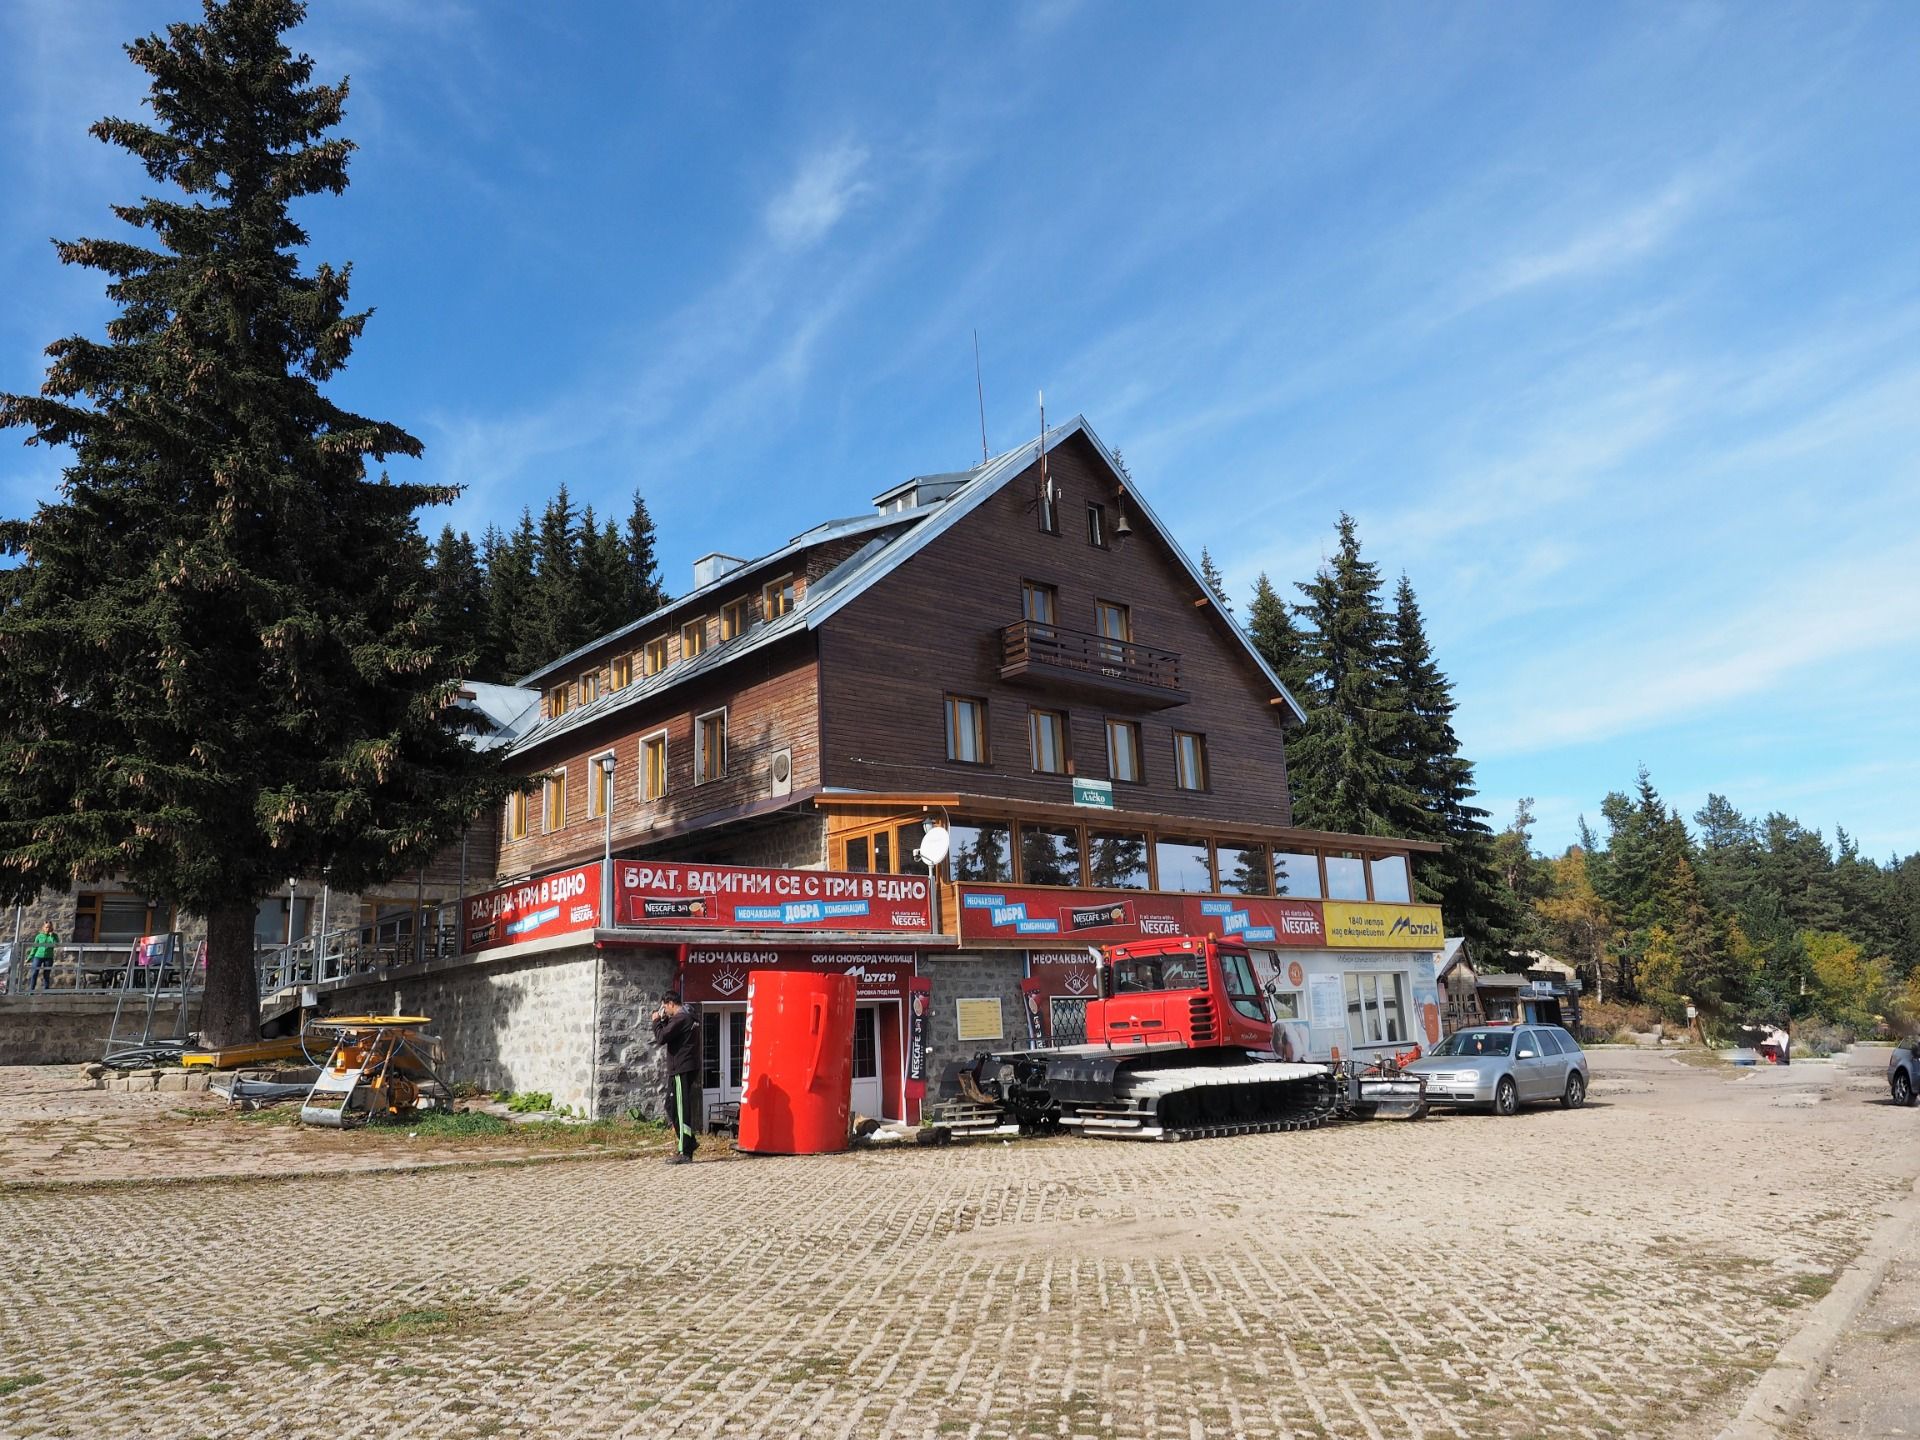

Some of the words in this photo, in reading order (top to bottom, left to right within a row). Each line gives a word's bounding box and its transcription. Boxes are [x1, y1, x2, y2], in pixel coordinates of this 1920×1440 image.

[624, 867, 682, 892] БРАТ,
[687, 870, 771, 894] ВДИГНИ
[775, 875, 800, 895] СЕ
[804, 876, 819, 895] С
[823, 877, 858, 897] ТРИ
[862, 879, 874, 897] В
[877, 880, 926, 901] ЕДНО
[471, 885, 539, 919] РАЗ-ДВА-ТРИ
[541, 882, 549, 903] В
[551, 873, 586, 902] ЕДНО
[738, 909, 781, 919] НЕОЧАКВАНО
[785, 904, 820, 922] ДОБРА
[824, 903, 866, 914] КОМБИНАЦИЯ
[967, 897, 1003, 906] НЕОЧАКВАНО
[995, 907, 1024, 924] ДОБРА
[1020, 921, 1056, 931] КОМБИНАЦИЯ
[1225, 913, 1248, 932] ДОБРА
[1348, 917, 1362, 925] 1840
[1332, 929, 1342, 937] над
[1344, 928, 1385, 937] ежедневието
[688, 952, 779, 963] НЕОЧАКВАНО
[811, 955, 828, 963] СКИ
[829, 955, 835, 963] И
[836, 955, 877, 964] СНОУБОРД
[878, 955, 913, 964] УЧИЛИЩЕ
[1033, 954, 1096, 964] НЕОЧАКВАНО
[722, 978, 734, 989] ЯК
[1072, 979, 1081, 989] ЯК
